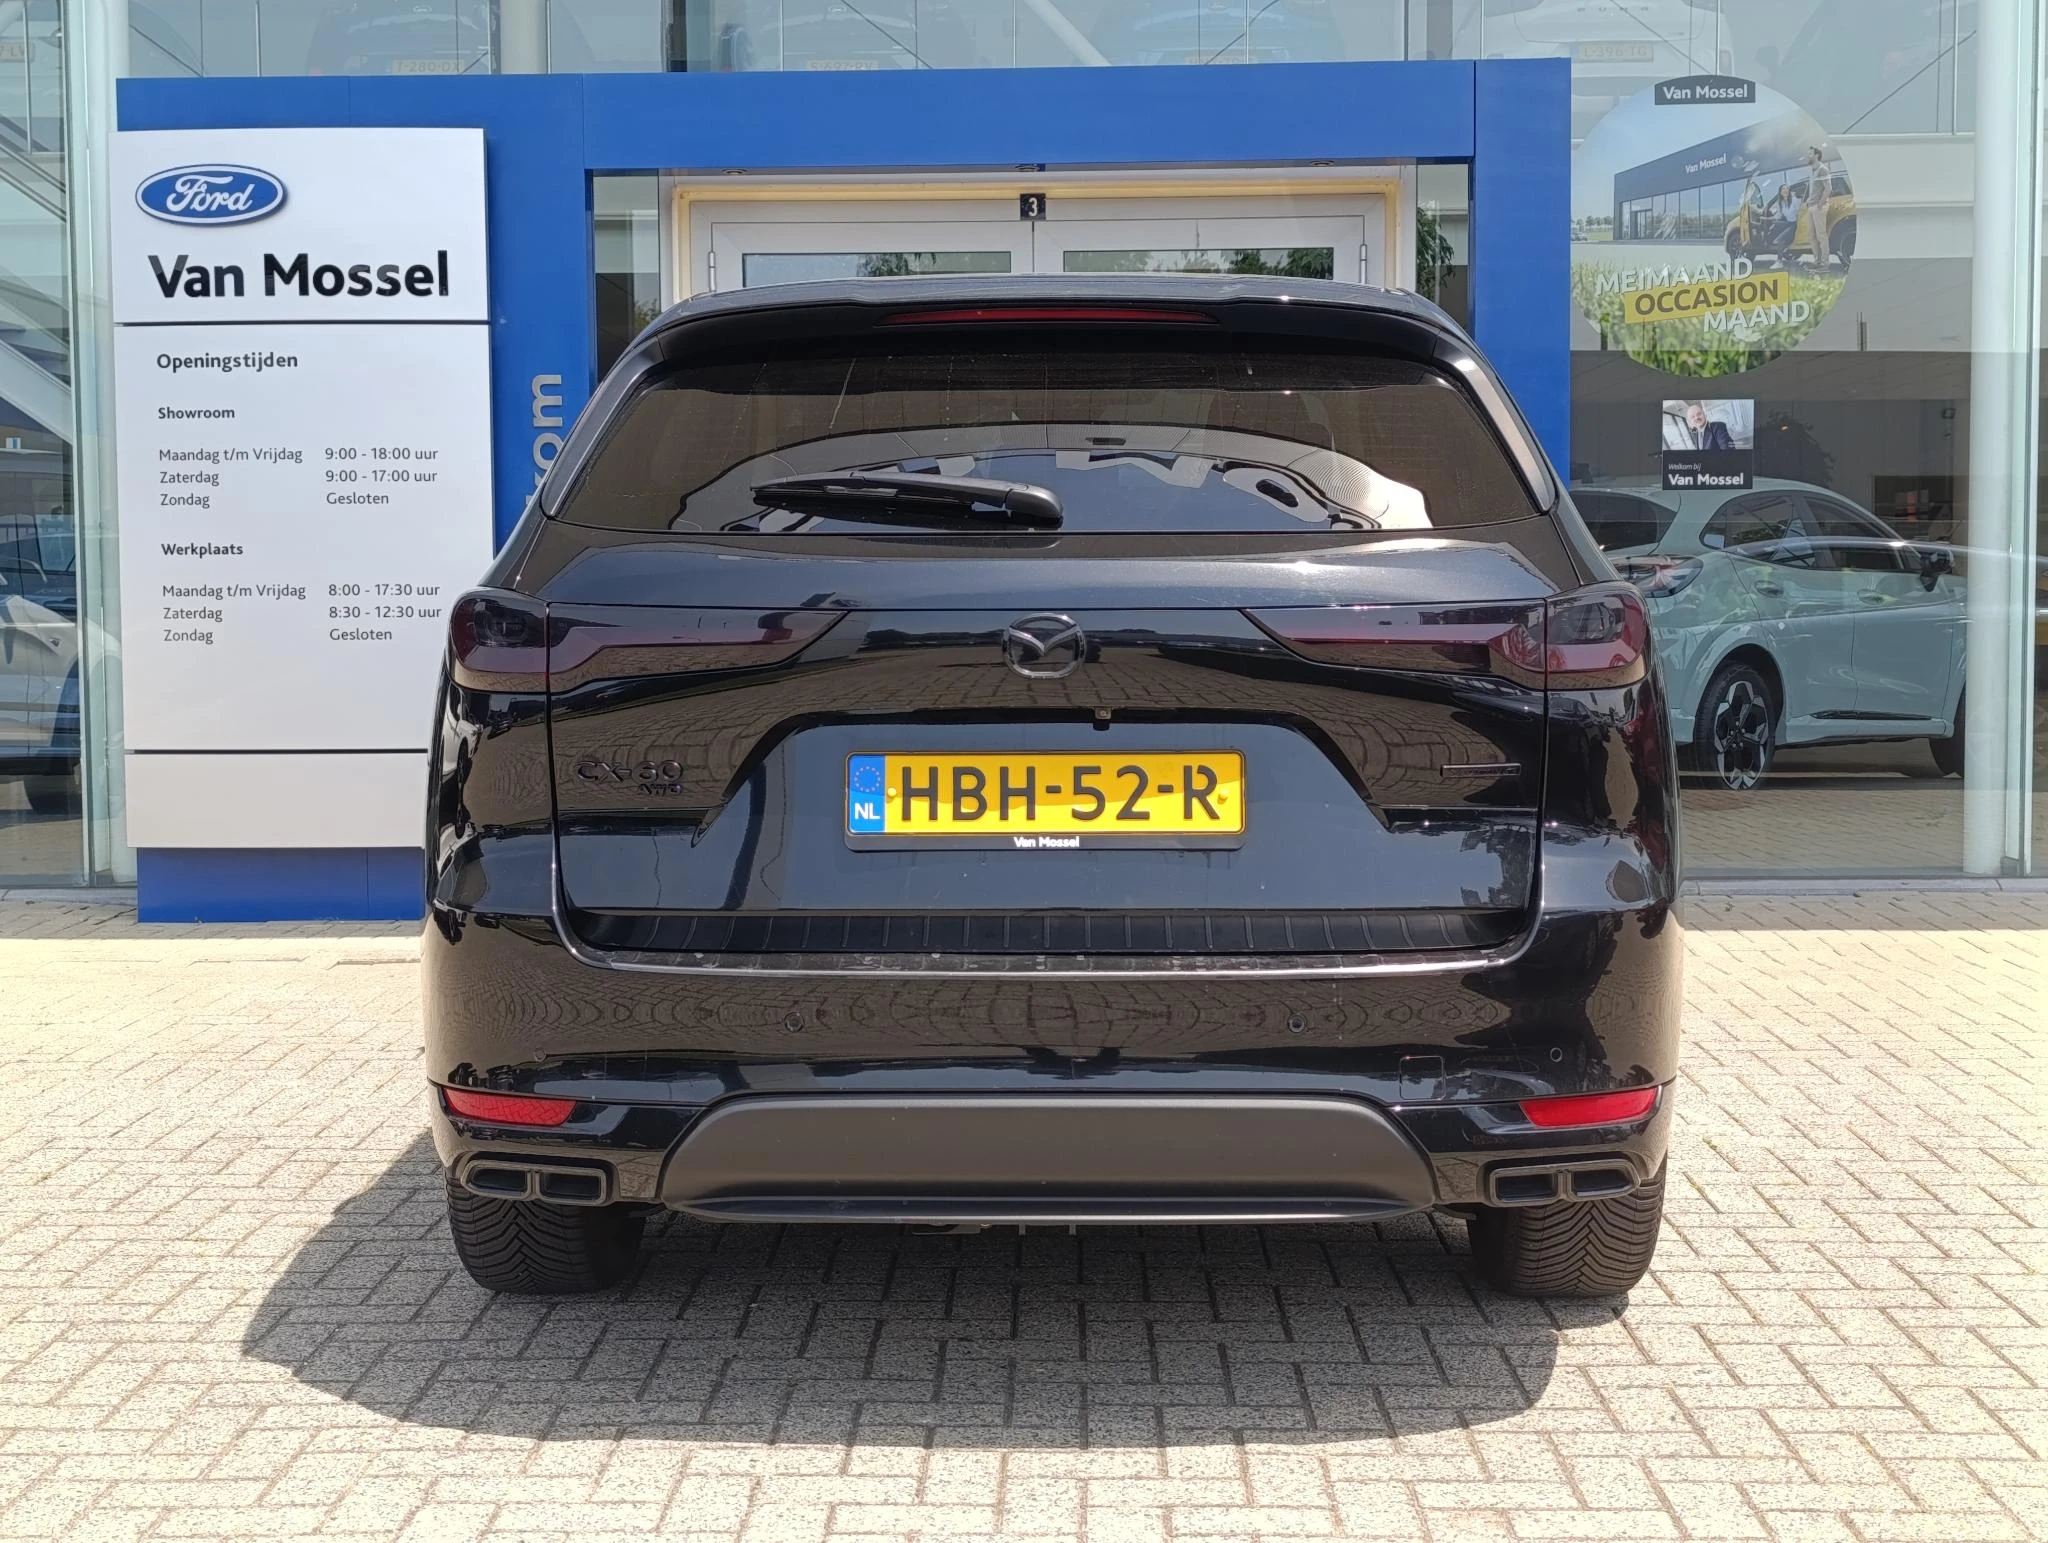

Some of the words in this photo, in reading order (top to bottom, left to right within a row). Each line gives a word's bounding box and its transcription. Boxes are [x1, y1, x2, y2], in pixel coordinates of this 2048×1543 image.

[1663, 87, 1691, 99] Van
[1696, 84, 1747, 98] Mossel
[1685, 165, 1698, 173] Van
[1700, 153, 1726, 170] Mossel
[167, 174, 255, 212] Ford
[1028, 197, 1038, 217] 3
[148, 255, 244, 297] Van
[264, 250, 448, 296] Mossel
[1596, 258, 1753, 295] MEIMAAND
[1635, 279, 1778, 315] OCCASION
[1704, 301, 1810, 332] MAAND
[157, 352, 297, 373] Openingstijden
[158, 407, 235, 419] Showroom
[160, 448, 219, 464] Maandag
[223, 448, 248, 460] t/m
[253, 448, 302, 463] Vrijdag
[325, 448, 356, 459] 9:00
[371, 448, 410, 459] 18:00
[415, 451, 438, 459] uur
[160, 471, 219, 486] Zaterdag
[326, 470, 357, 482] 9:00
[372, 470, 409, 482] 17:00
[414, 473, 437, 482] uur
[1668, 475, 1693, 485] Van
[1697, 473, 1743, 485] Mossel
[160, 493, 210, 509] Zondag
[327, 492, 388, 504] Gesloten
[161, 543, 243, 559] Werkplaats
[163, 584, 223, 600] Maandag
[227, 584, 252, 597] t/m
[256, 584, 306, 600] Vrijdag
[329, 584, 360, 596] 8:00
[375, 584, 412, 596] 17:30
[417, 587, 440, 595] uur
[163, 606, 222, 622] Zaterdag
[330, 607, 360, 618] 8:30
[375, 606, 414, 617] 12:30
[419, 609, 441, 617] uur
[164, 629, 213, 645] Zondag
[330, 628, 392, 640] Gesloten
[902, 765, 1220, 822] HBH-52-R
[855, 804, 880, 819] NL
[1014, 837, 1036, 847] Van
[1039, 837, 1079, 847] Mossel
